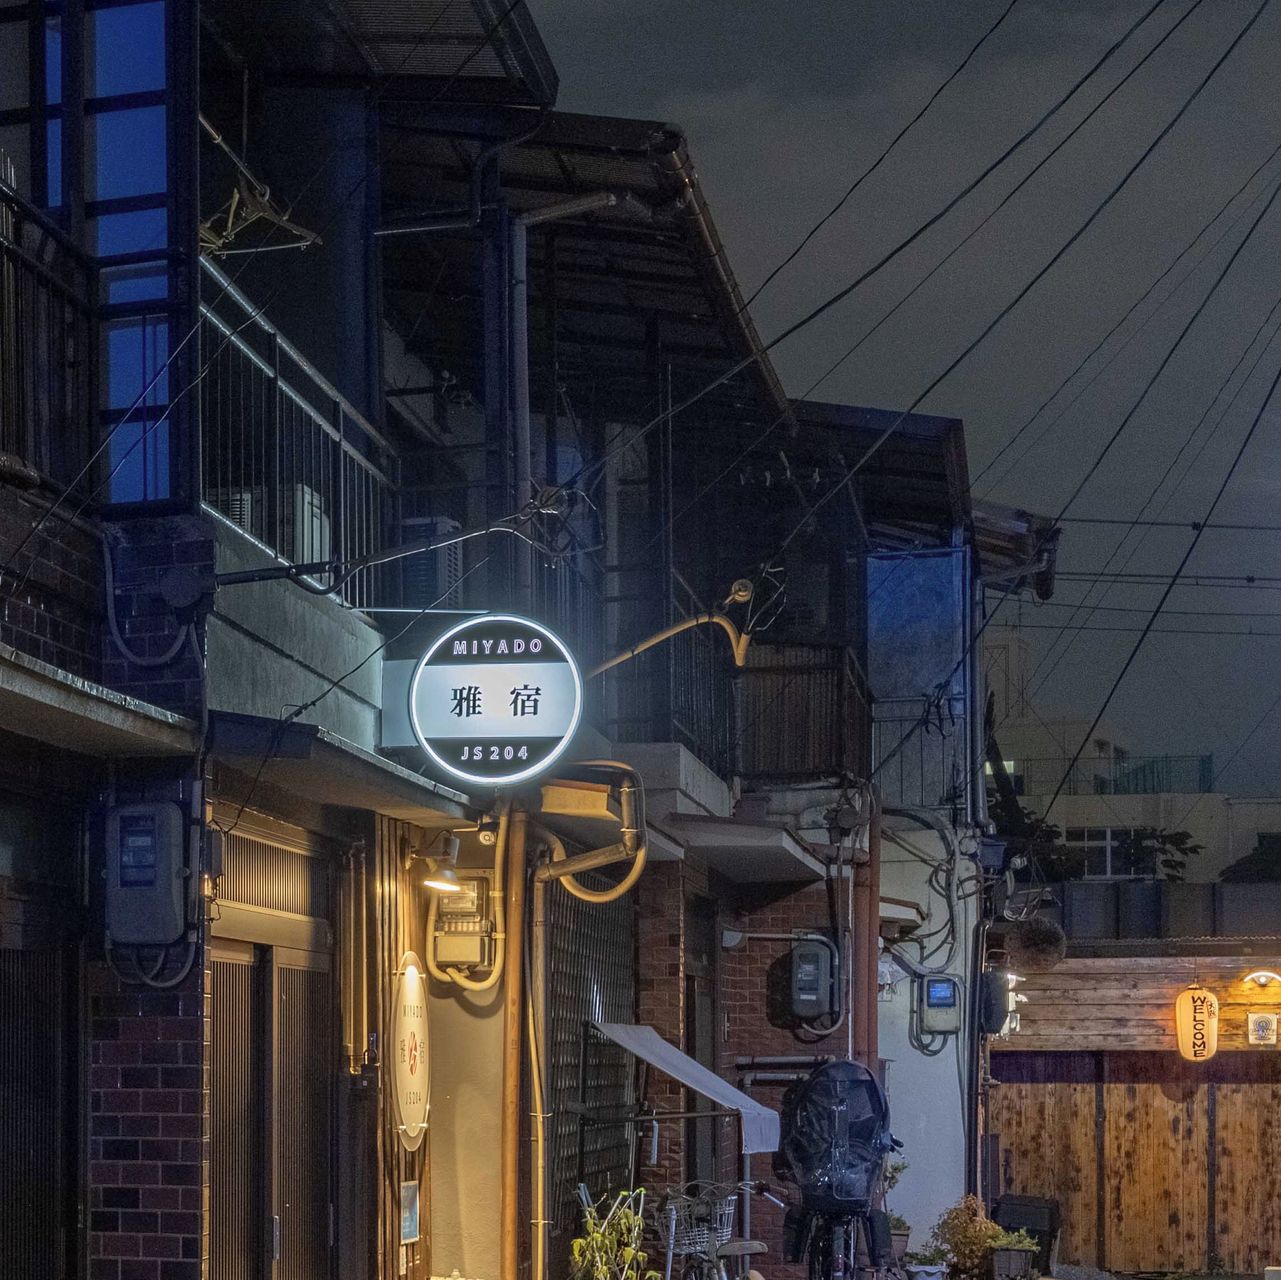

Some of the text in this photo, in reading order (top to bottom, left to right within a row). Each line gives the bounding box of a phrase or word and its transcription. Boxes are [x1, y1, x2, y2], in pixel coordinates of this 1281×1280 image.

[453, 638, 542, 655] MIYADO
[450, 684, 542, 718] 雅宿
[461, 746, 528, 760] JS204
[1191, 995, 1207, 1058] WELCOME
